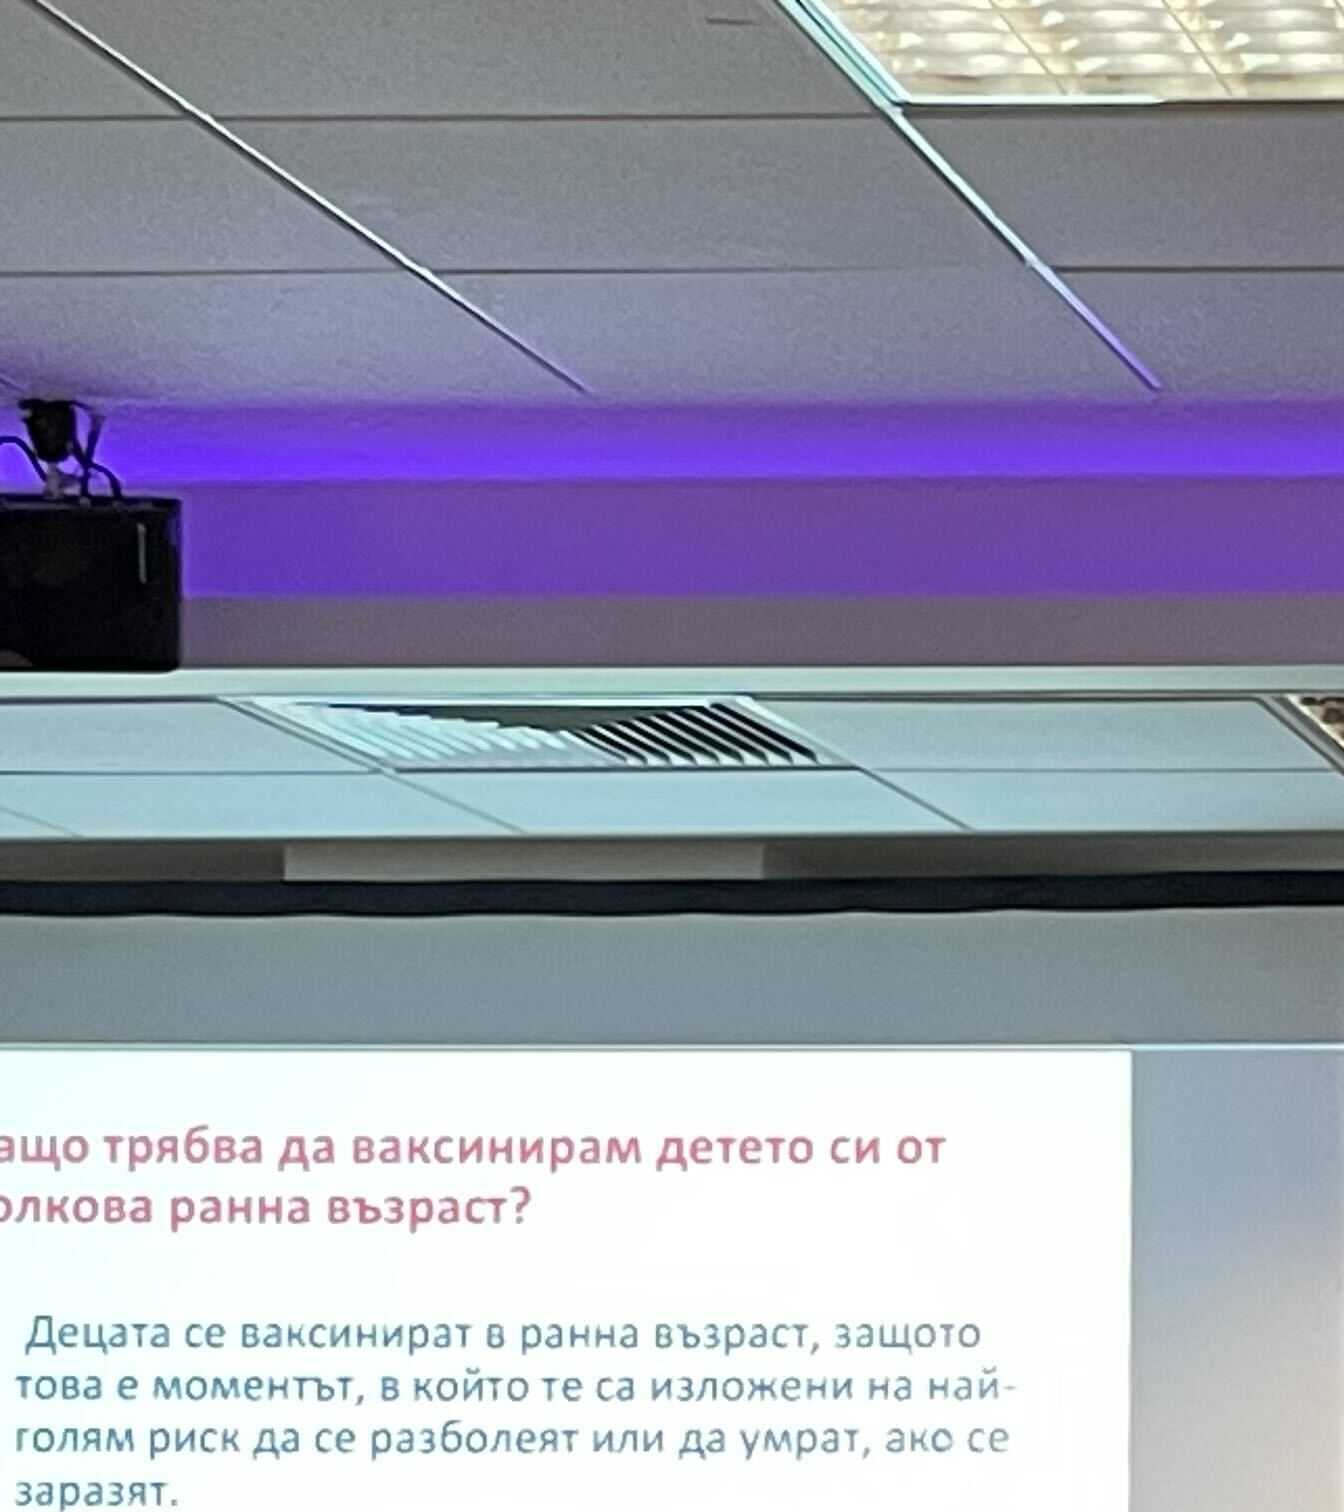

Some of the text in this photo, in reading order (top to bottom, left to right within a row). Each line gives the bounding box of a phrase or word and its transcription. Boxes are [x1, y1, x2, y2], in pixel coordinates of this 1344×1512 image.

[103, 1124, 262, 1172] трябва
[278, 1136, 335, 1172] да
[352, 1136, 642, 1174] ваксинирам
[656, 1136, 813, 1172] детето
[830, 1136, 880, 1164] си
[896, 1136, 946, 1164] от
[171, 1196, 310, 1233] ранна
[328, 1186, 531, 1234] възраст?
[24, 1315, 980, 1356] Децата се ваксинират в ранна възраст, защото
[15, 1366, 1016, 1406] това е моментът, в който те са изложени на най-
[16, 1420, 1009, 1461] голям риск да се разболеят или да умрат, ако се
